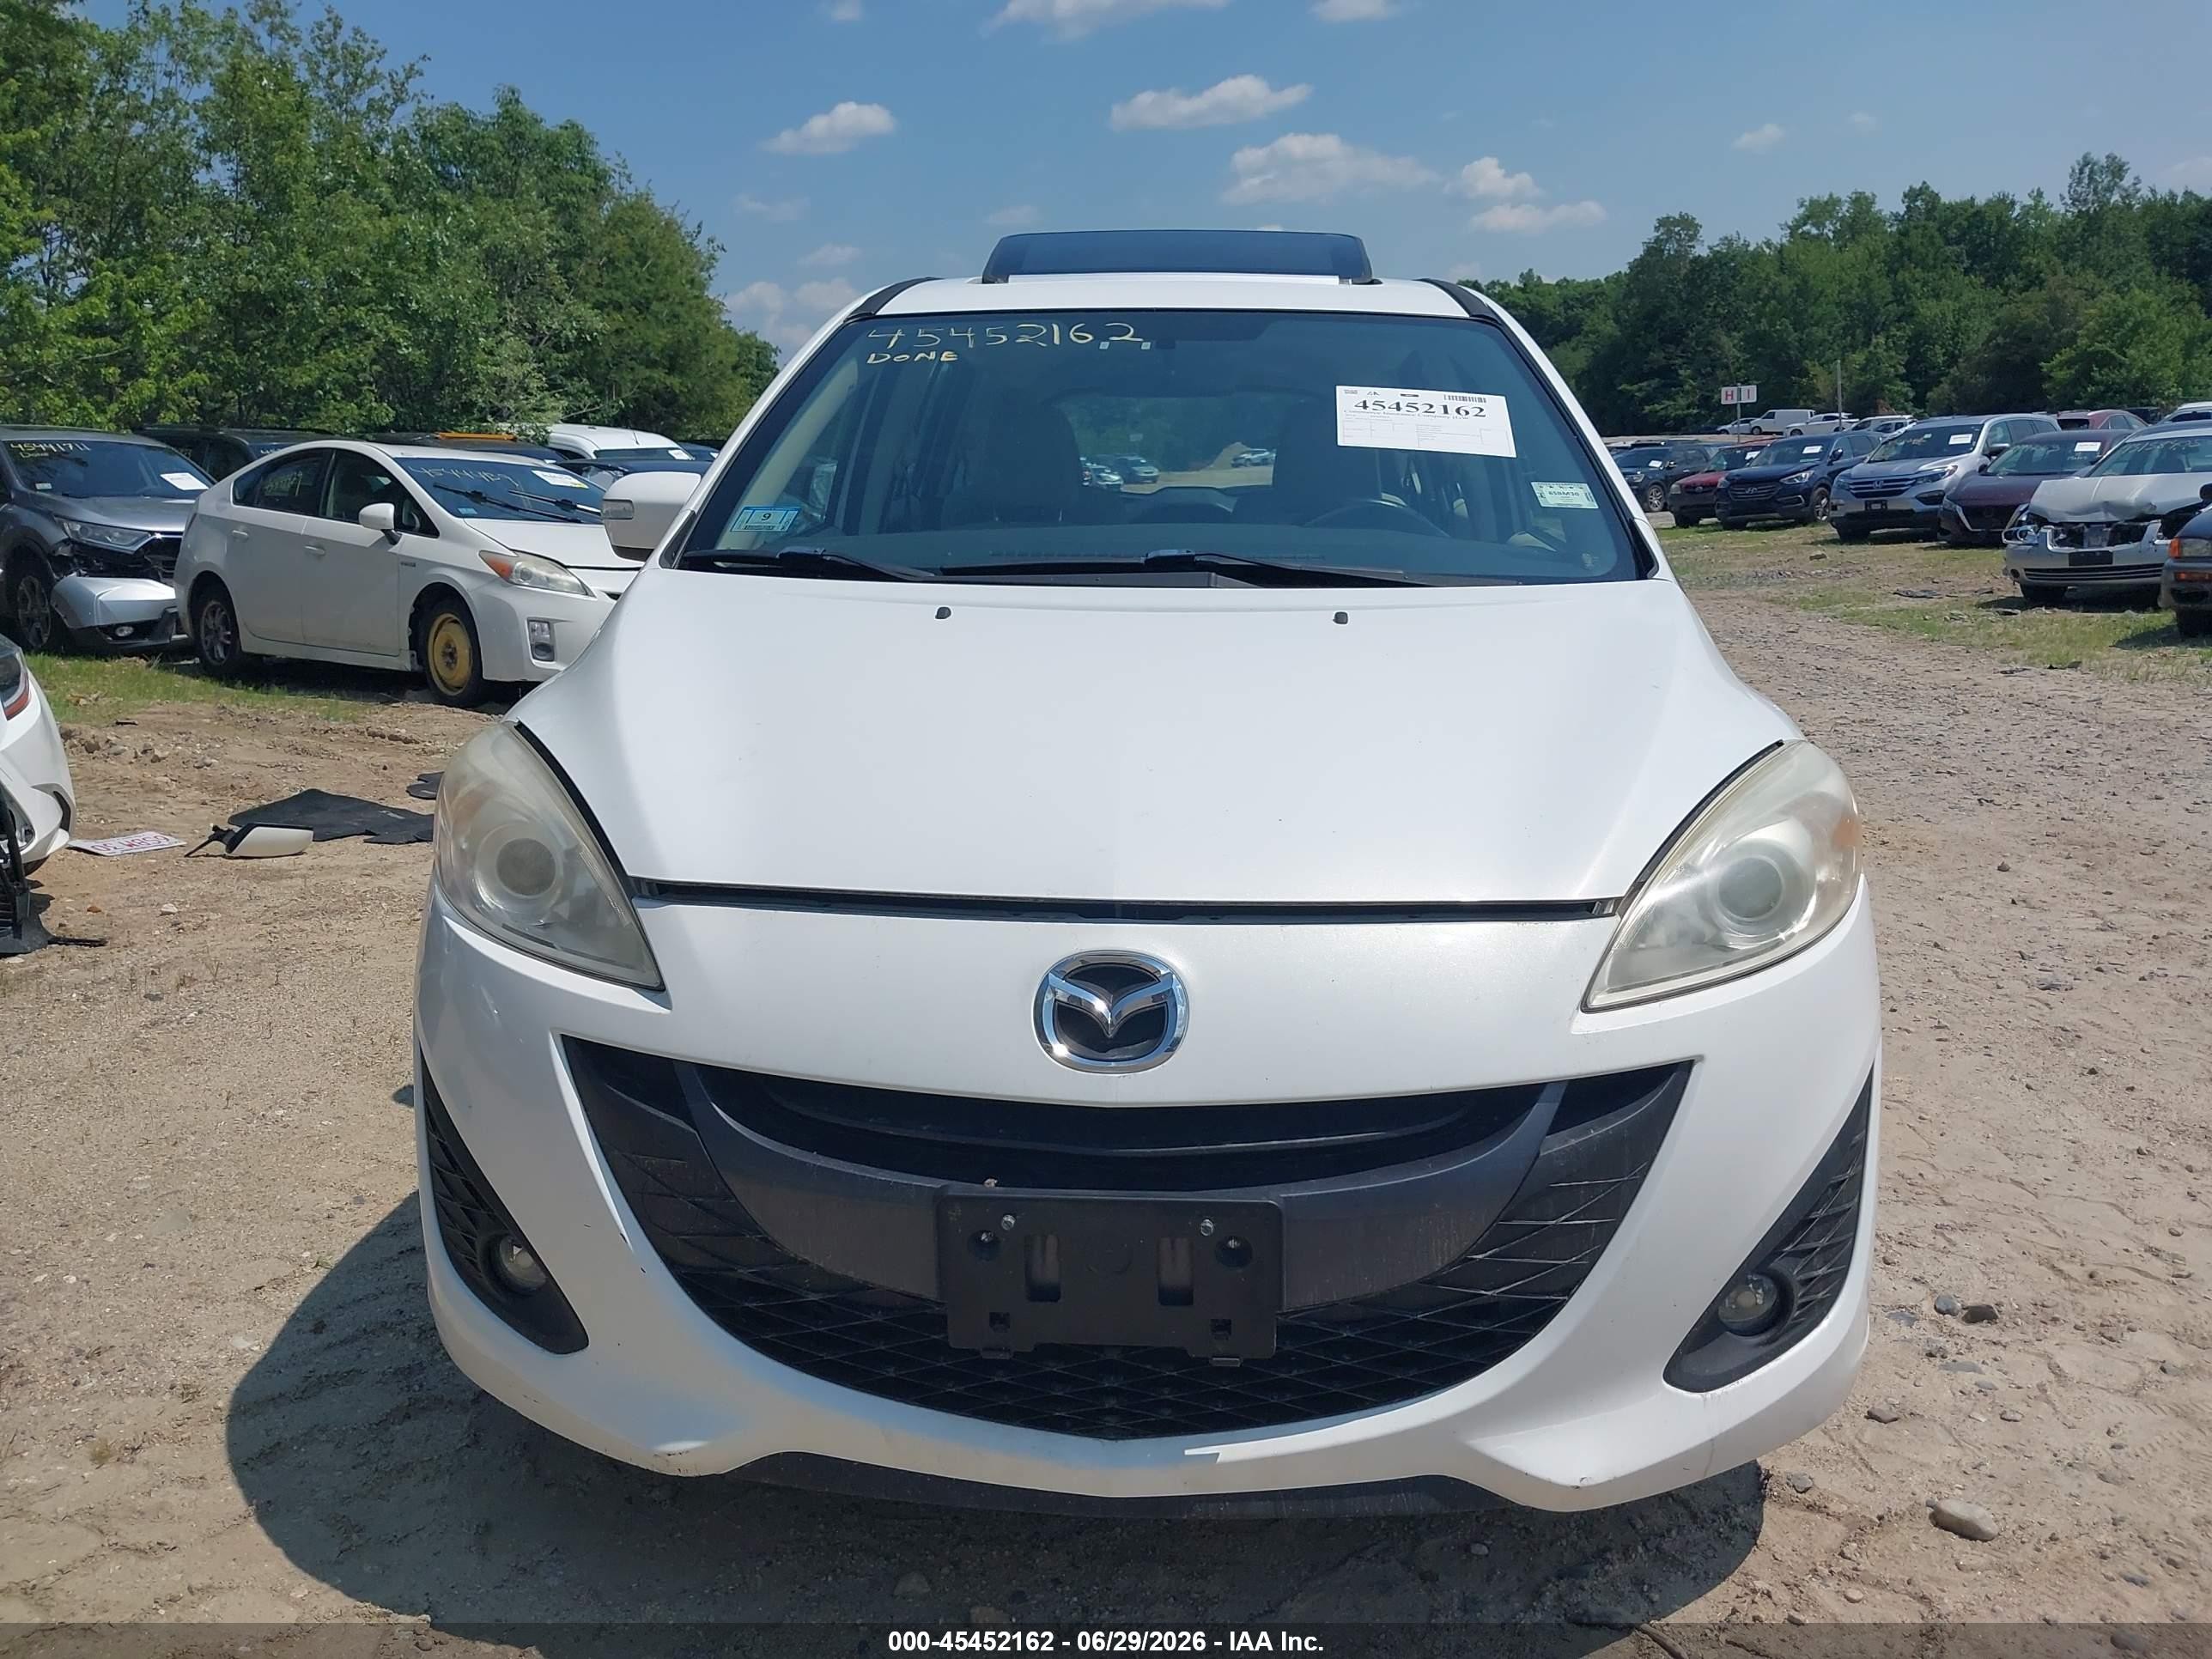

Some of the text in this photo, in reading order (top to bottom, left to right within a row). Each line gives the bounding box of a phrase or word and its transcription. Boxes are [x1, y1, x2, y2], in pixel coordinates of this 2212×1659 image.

[867, 323, 1144, 349] 45452162
[866, 351, 959, 364] DONE
[1725, 390, 1734, 401] H
[1354, 399, 1486, 417] 45452162
[761, 513, 771, 521] 9
